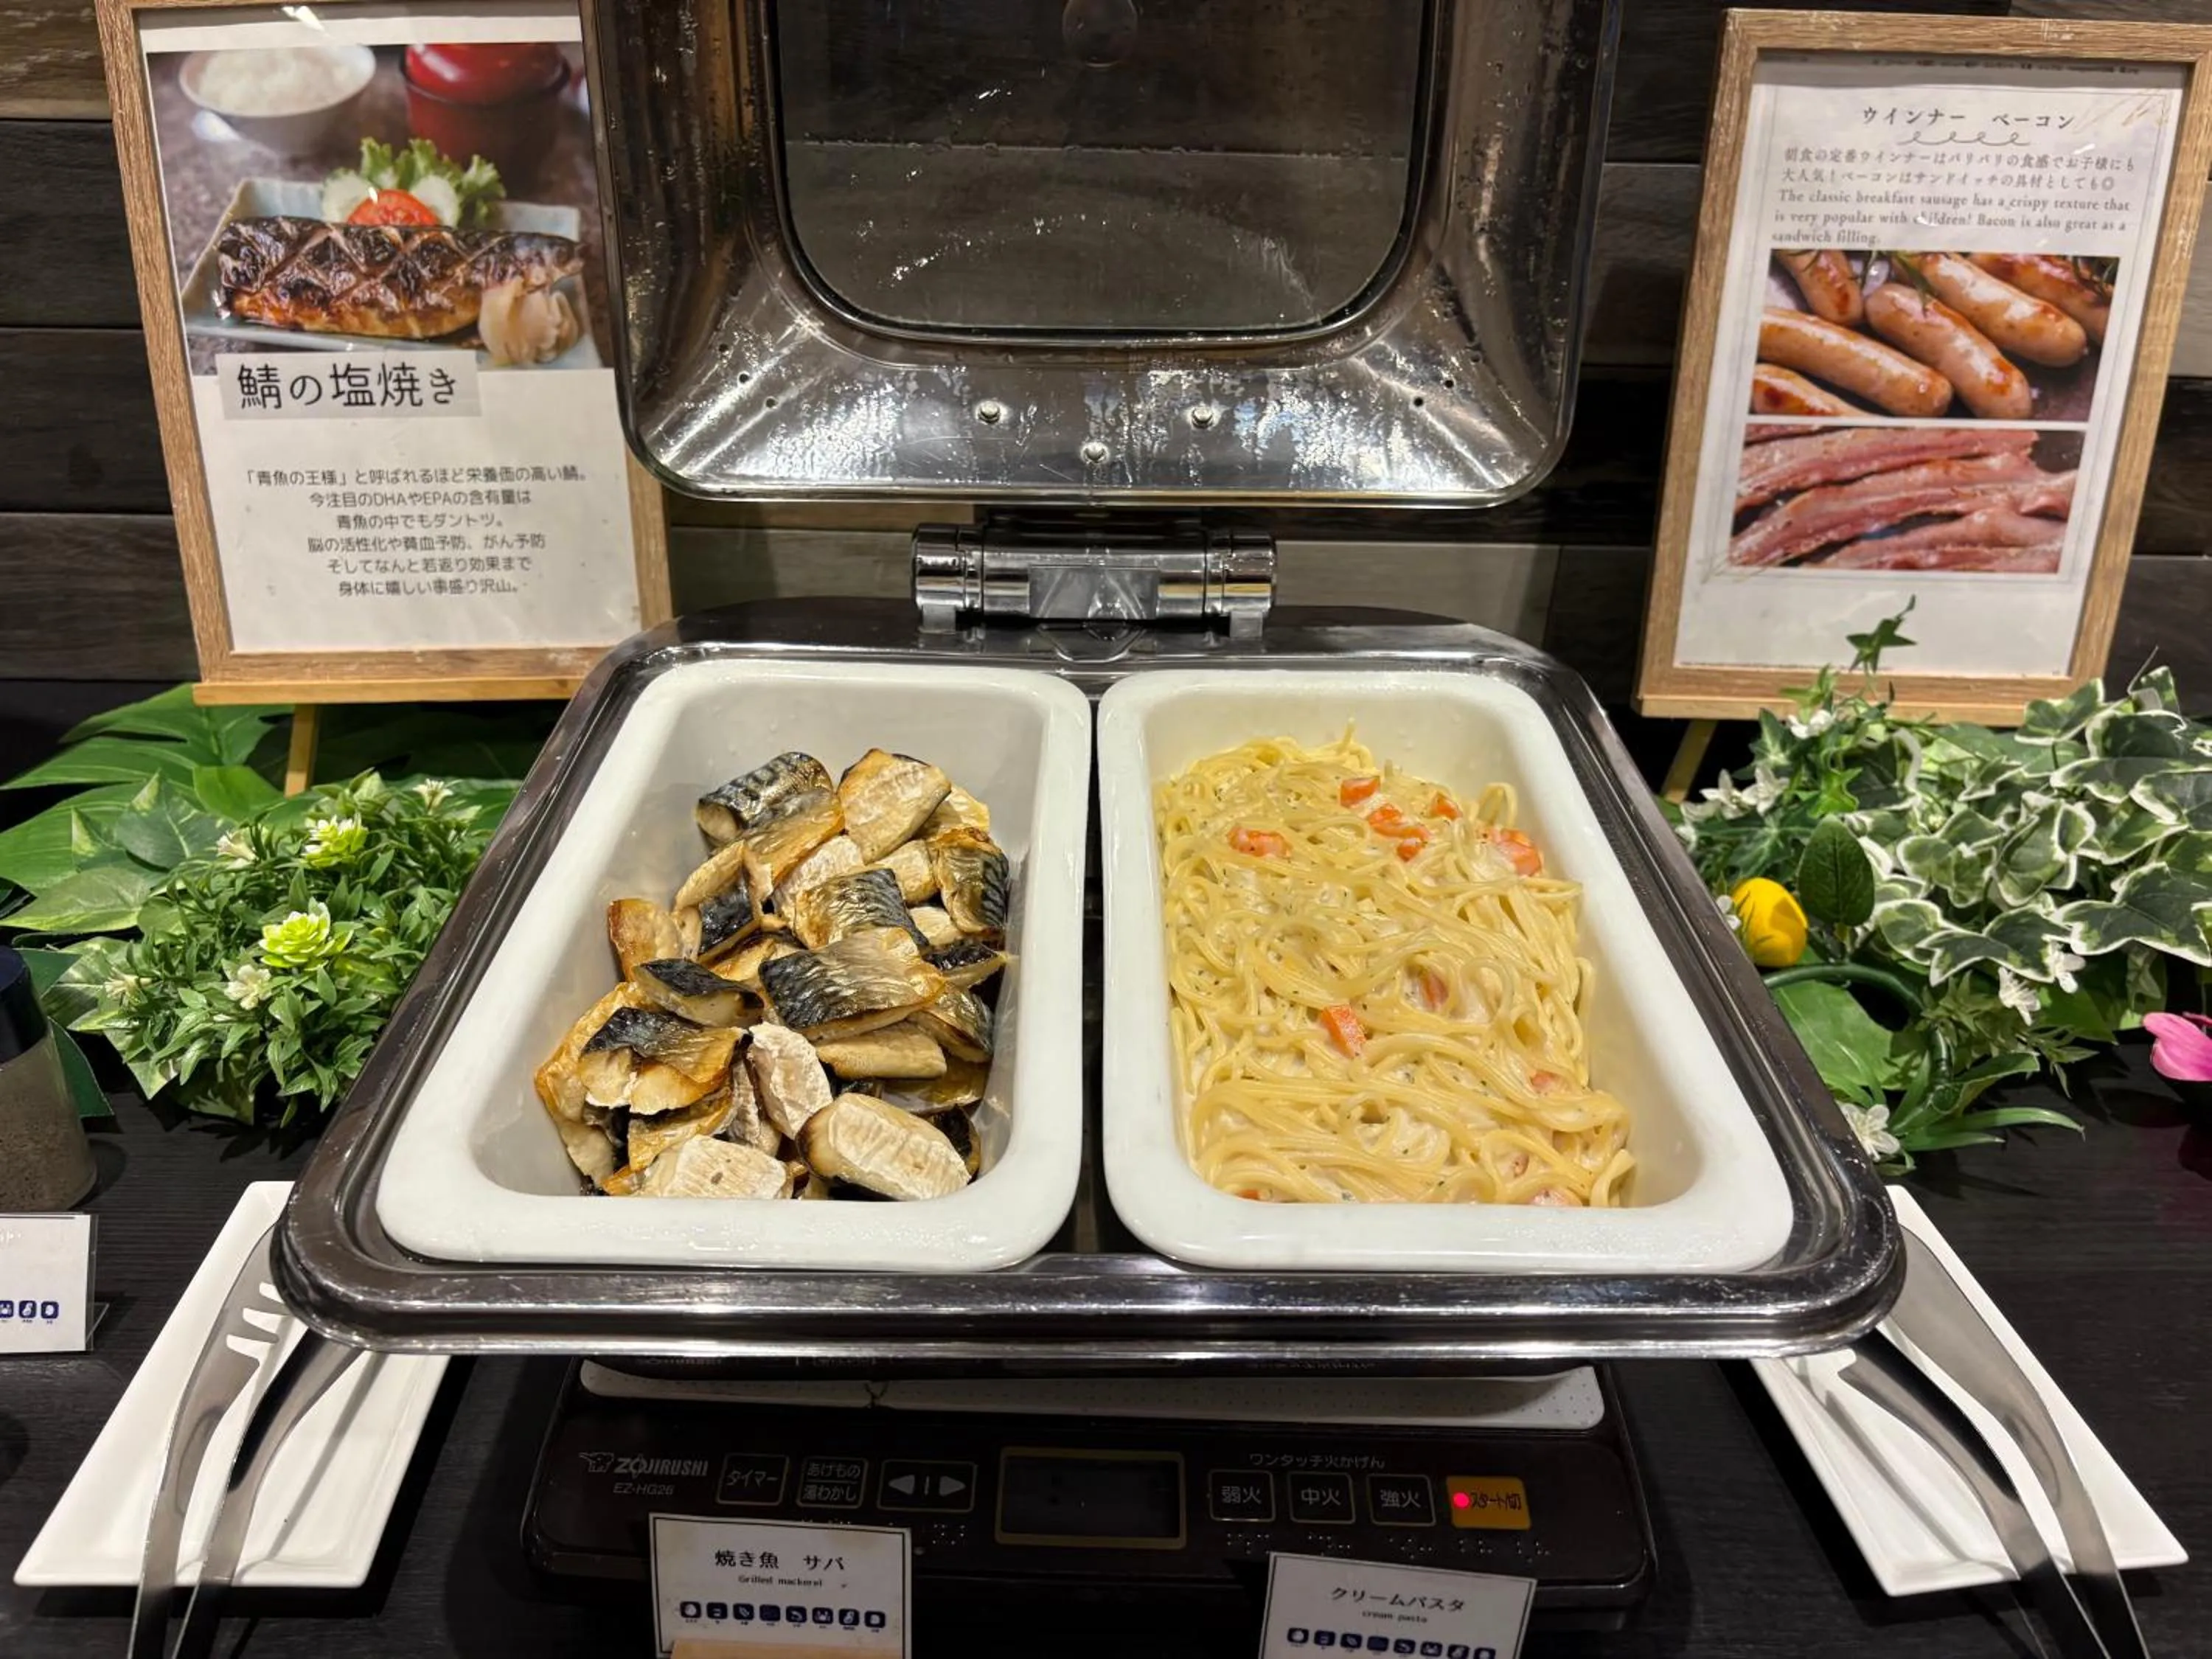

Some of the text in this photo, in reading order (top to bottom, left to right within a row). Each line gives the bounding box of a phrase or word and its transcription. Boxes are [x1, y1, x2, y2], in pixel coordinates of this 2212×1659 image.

[1863, 106, 2074, 130] ウインナー ベーコン
[1779, 189, 1804, 202] The
[1809, 189, 1851, 203] classic
[1857, 190, 1914, 204] breakfast
[1920, 195, 1968, 209] sausage
[1973, 193, 1993, 206] has
[2009, 195, 2048, 211] crispy
[2054, 198, 2099, 210] texture
[2104, 198, 2130, 211] that
[1775, 210, 1785, 221] is
[1790, 214, 1818, 226] very
[1823, 211, 1874, 226] popular
[1879, 211, 1907, 223] with
[1978, 214, 2015, 227] Bacon
[2021, 215, 2030, 227] is
[2035, 215, 2060, 228] also
[2065, 220, 2098, 233] great
[2101, 222, 2115, 231] as
[1772, 229, 1879, 247] sandwich filling.
[237, 361, 457, 410] 鯖の塩焼き
[336, 512, 504, 529] 青魚の中でもダントツ。
[327, 556, 532, 574] そしてなんと若返り効果まで
[1249, 1453, 1385, 1470] ワンタッチ火かげん
[725, 1469, 779, 1488] タイマー
[1222, 1485, 1262, 1505] 弱火
[1300, 1487, 1340, 1506] 中火
[1380, 1489, 1420, 1509] 強火
[715, 1549, 845, 1571] 焼き魚 サバ
[738, 1574, 773, 1585] Grilled
[1330, 1587, 1466, 1612] クリームパスタ
